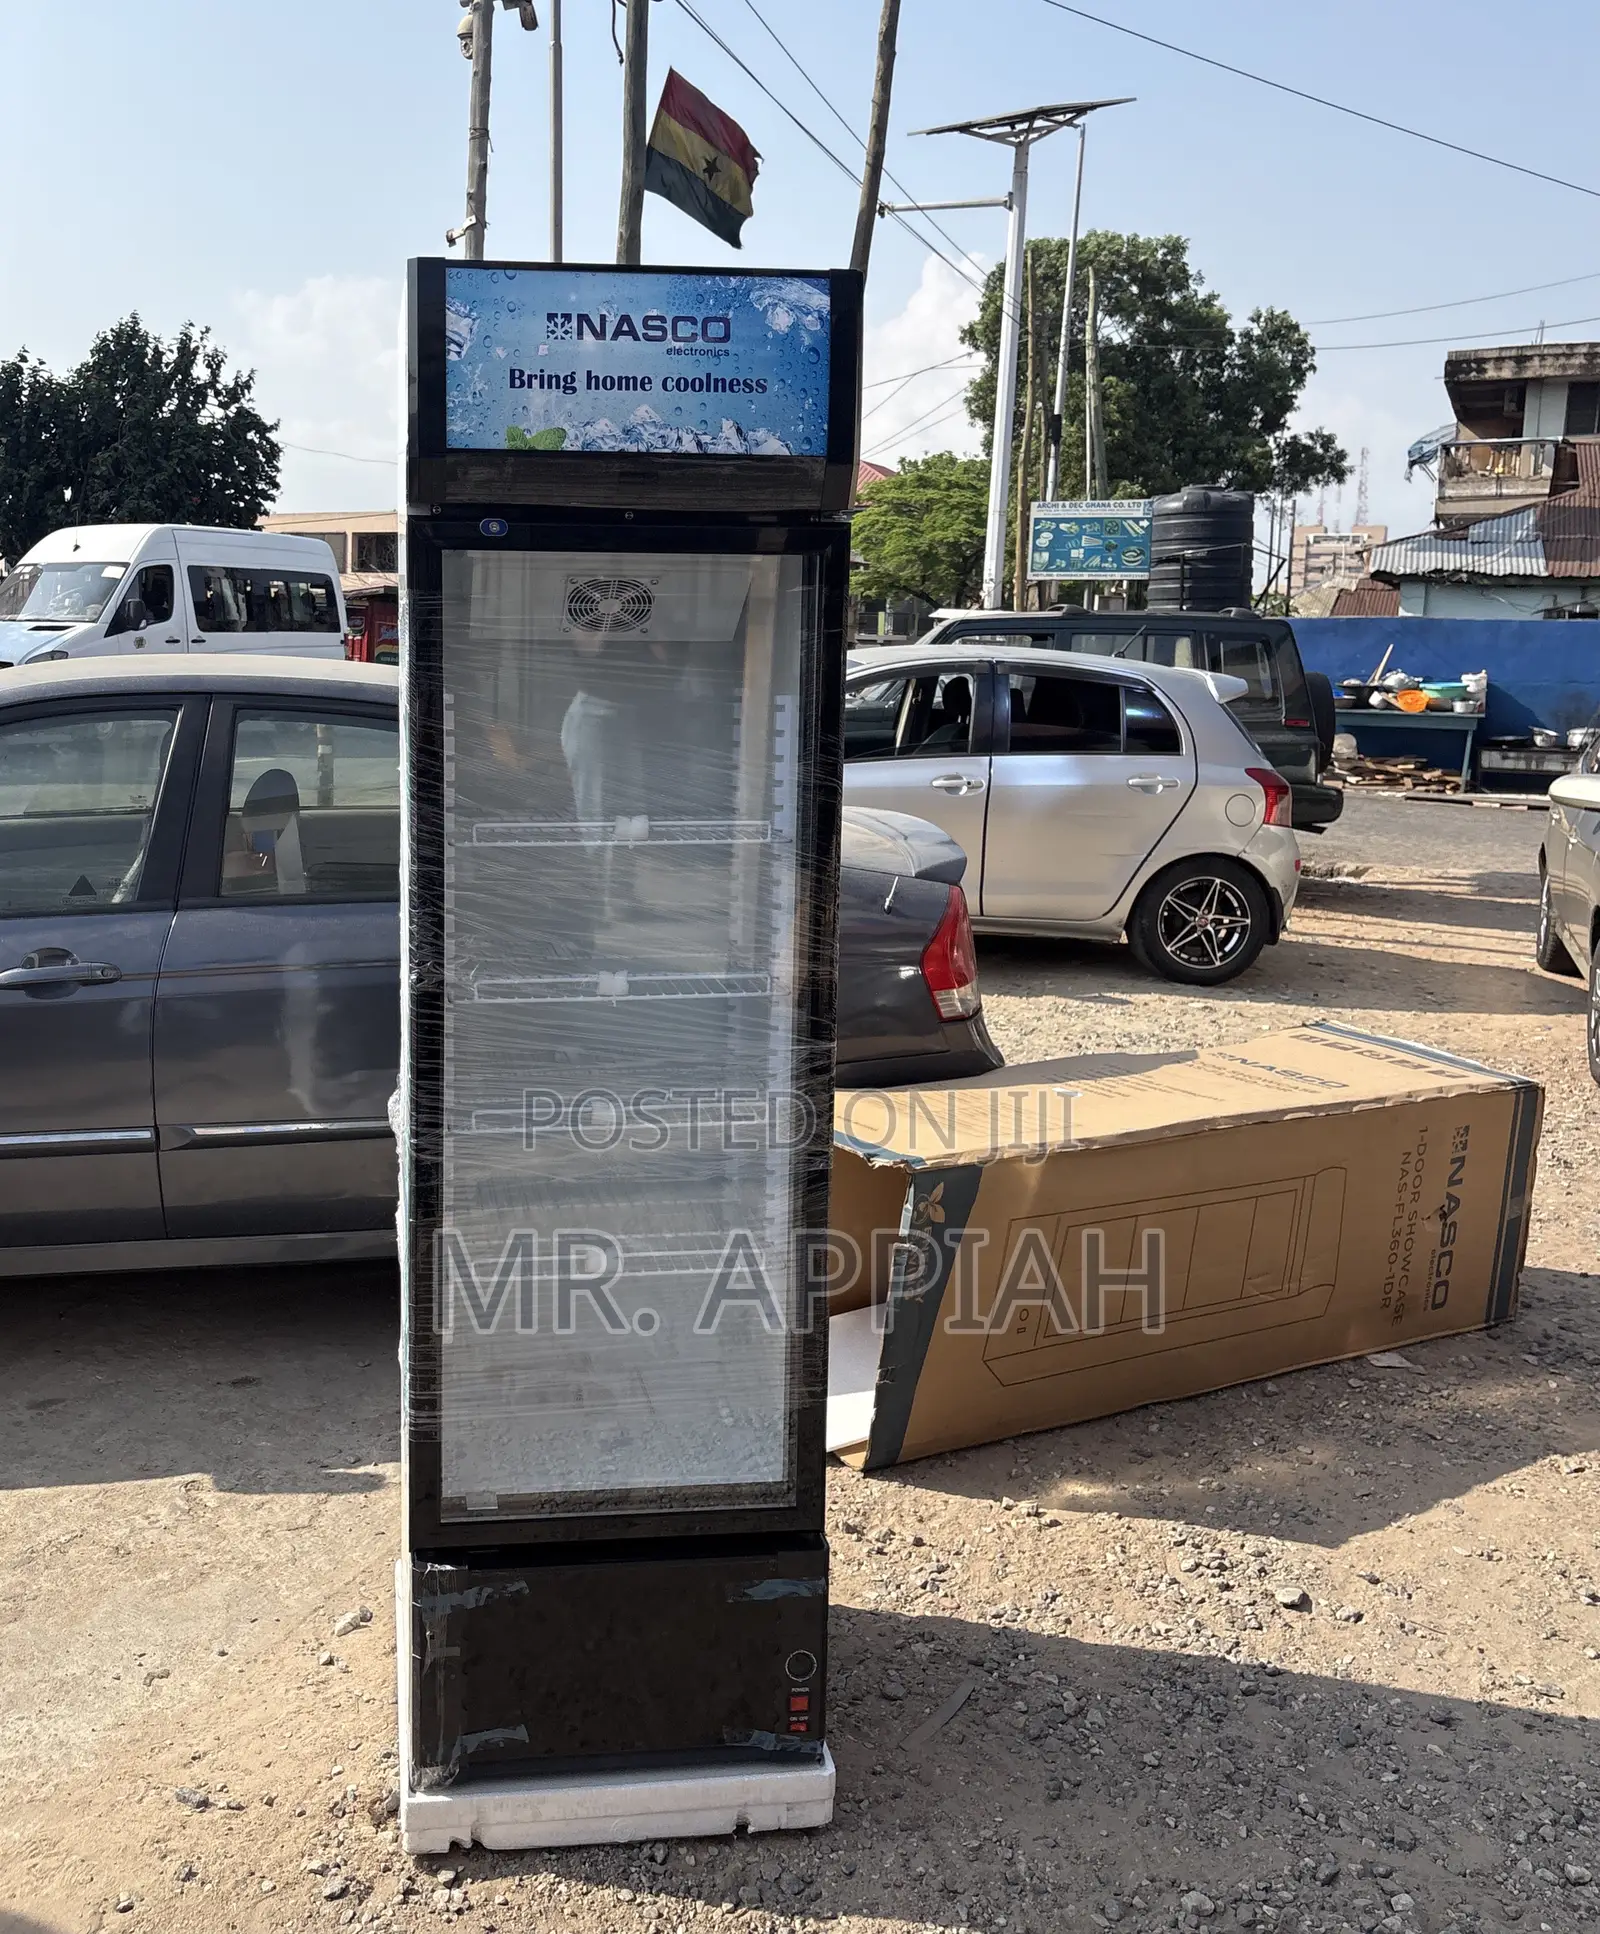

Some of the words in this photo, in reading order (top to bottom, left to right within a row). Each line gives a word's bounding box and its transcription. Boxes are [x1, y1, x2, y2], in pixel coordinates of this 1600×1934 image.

[576, 313, 731, 344] NASCO
[666, 346, 730, 357] electronics
[508, 368, 577, 395] Bring
[586, 370, 653, 393] home
[661, 372, 768, 395] coolness
[1085, 501, 1111, 509] GHANA
[1228, 1057, 1349, 1088] NASCO
[1410, 1126, 1428, 1204] 1-DOOR
[1380, 1151, 1412, 1310] NAS-FL360-1DR
[1431, 1155, 1466, 1311] NASCO
[1391, 1210, 1418, 1327] SHOWCASE
